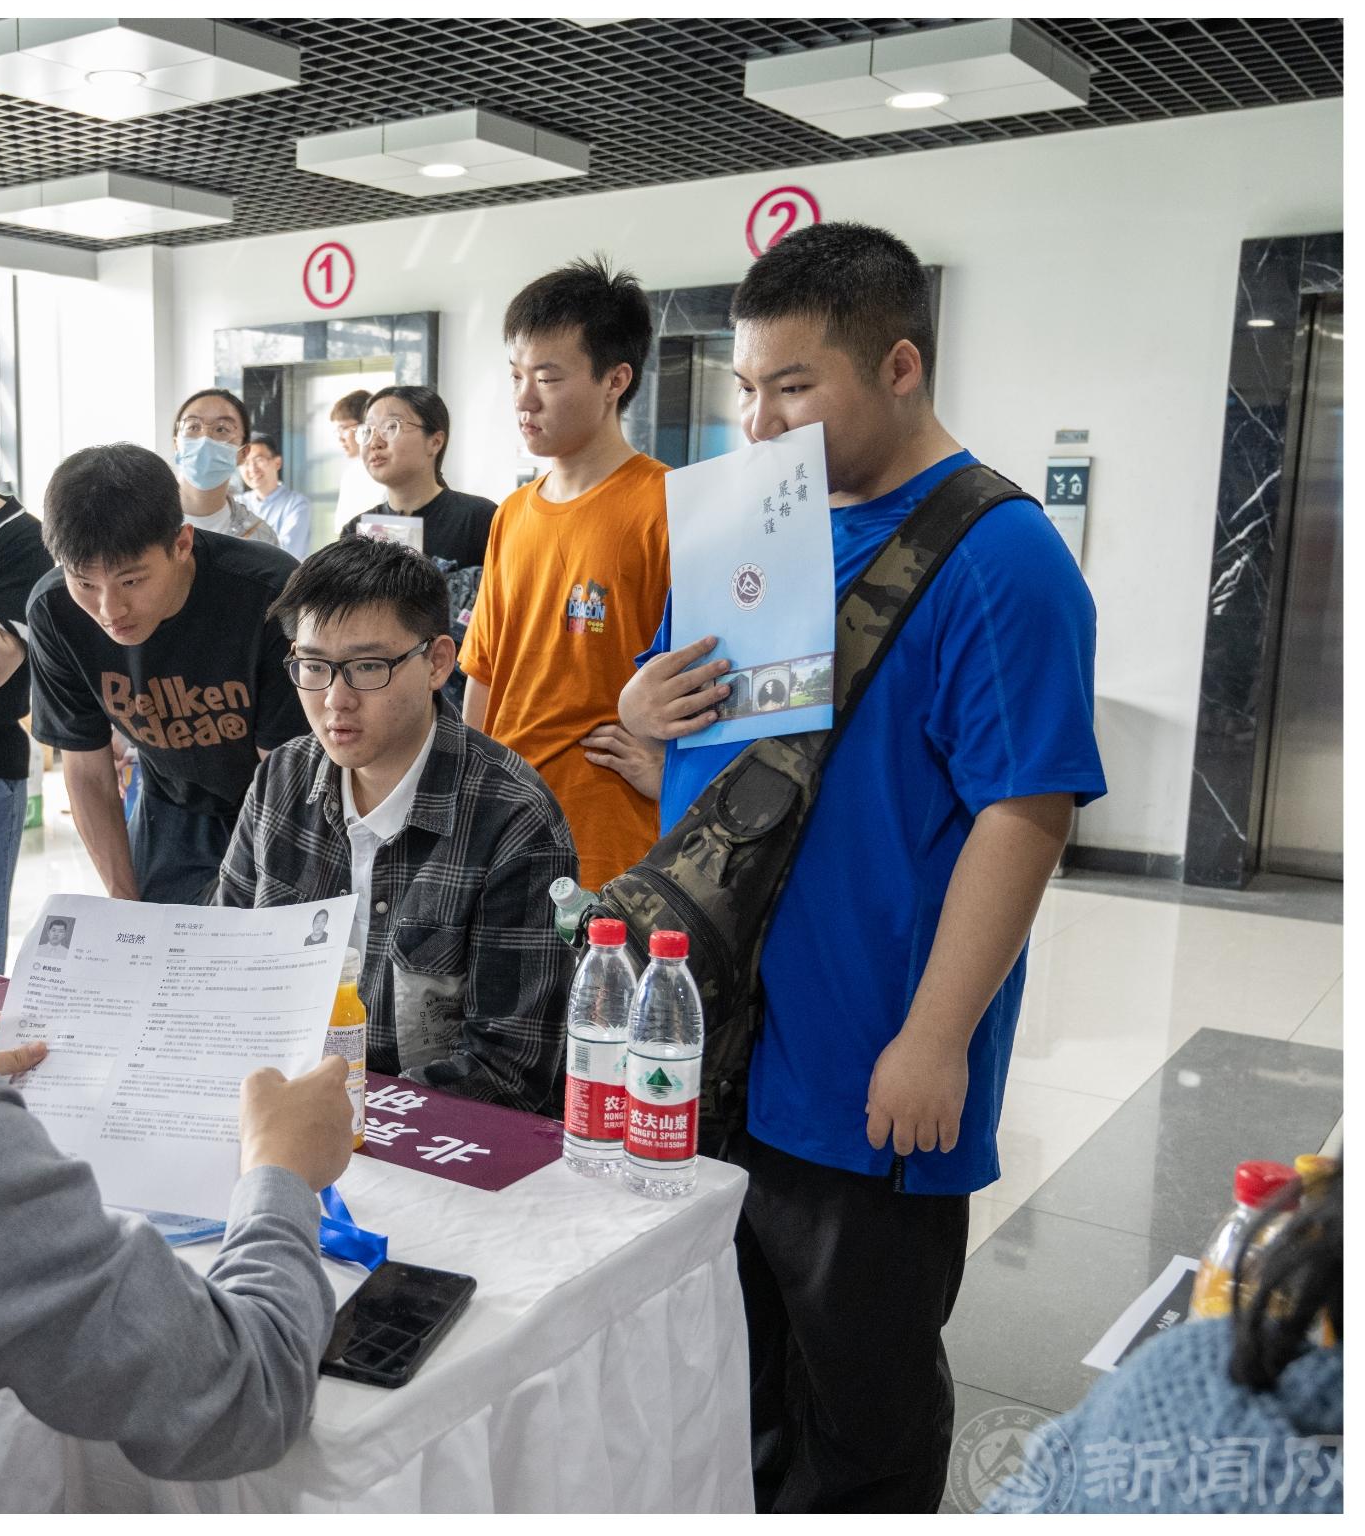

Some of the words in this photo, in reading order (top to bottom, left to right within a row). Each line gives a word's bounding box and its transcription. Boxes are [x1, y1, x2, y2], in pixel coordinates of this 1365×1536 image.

[101, 671, 251, 720] Bellken
[630, 1109, 688, 1131] 农夫山泉
[629, 1124, 657, 1140] NONGFU
[659, 1130, 687, 1140] SPRING
